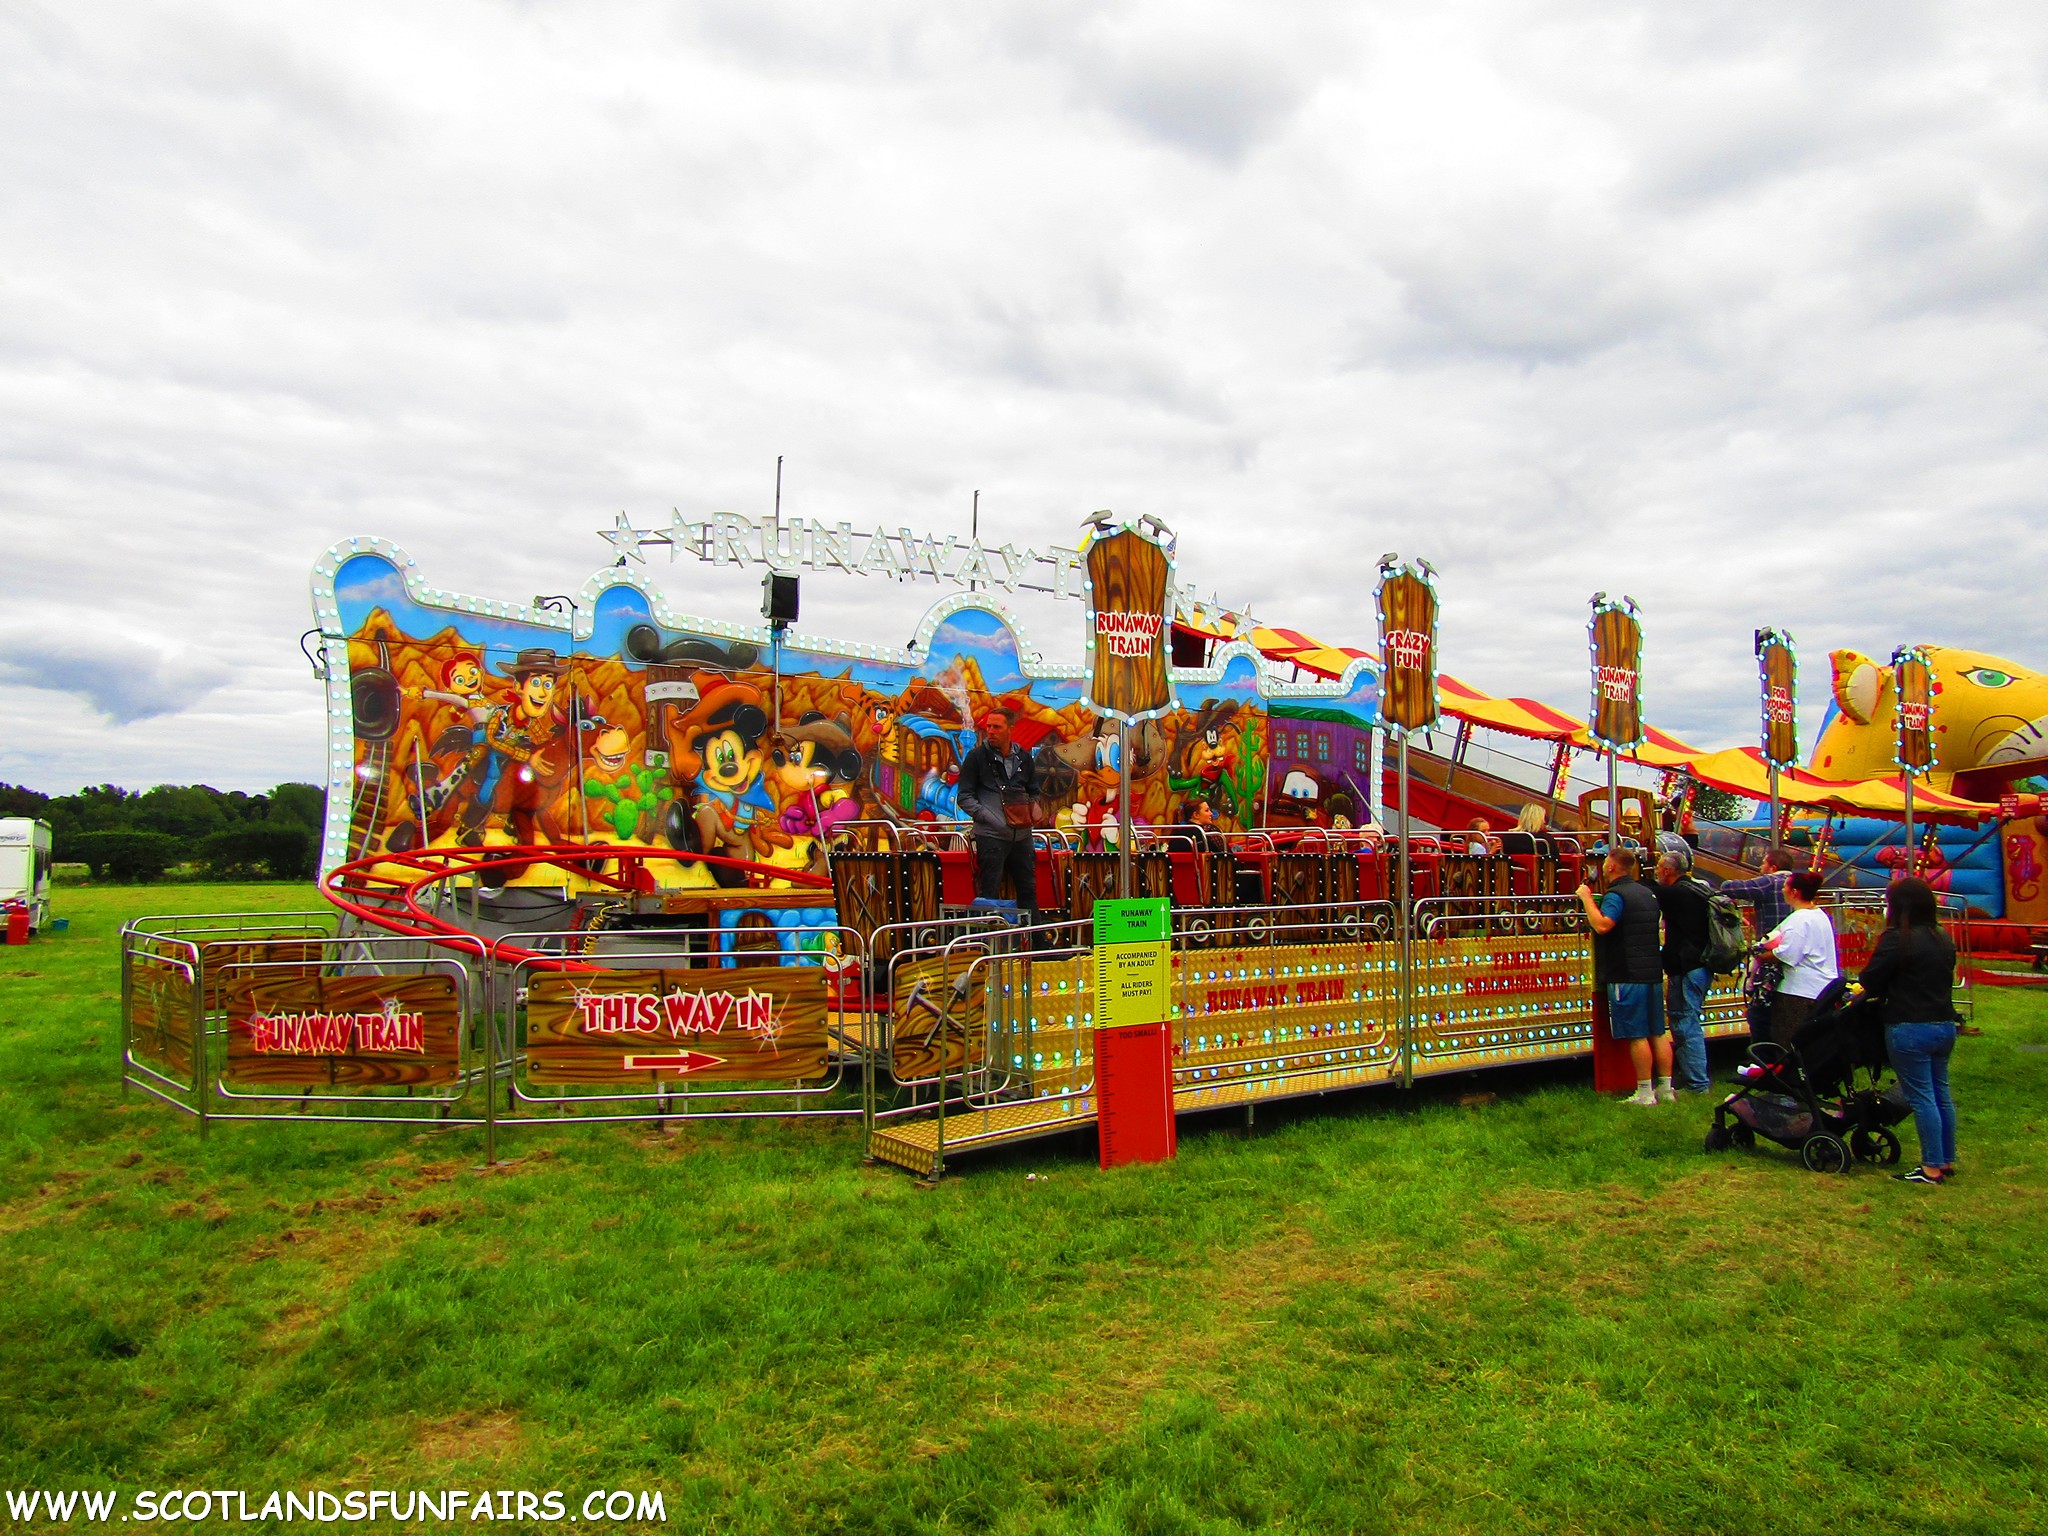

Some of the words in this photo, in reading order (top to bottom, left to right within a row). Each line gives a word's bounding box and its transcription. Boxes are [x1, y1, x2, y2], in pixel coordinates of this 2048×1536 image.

[711, 511, 1036, 594] RUNAWAY
[1096, 610, 1163, 638] RUNAWAY
[1108, 635, 1152, 658] TRAIN
[1385, 629, 1431, 655] CRAZY
[1395, 651, 1422, 672] FUN
[1597, 665, 1637, 688] RUNAWAY
[1604, 683, 1630, 703] TRAIN
[1771, 686, 1786, 700] FOR
[1766, 697, 1792, 714] YOUNG
[1776, 711, 1790, 724] OLD
[1120, 909, 1153, 918] RUNAWAY
[1127, 920, 1147, 928] TRAIN
[1115, 951, 1158, 961] ACCOMPANIED
[1118, 961, 1127, 969] BY
[1127, 960, 1136, 968] AN
[1137, 959, 1155, 967] ADULT
[1122, 989, 1139, 998] MUST
[1139, 988, 1152, 997] PAY!
[1132, 980, 1153, 989] RIDERS
[1206, 984, 1288, 1013] RUNAWAY
[1296, 978, 1345, 1003] TRAIN
[578, 992, 661, 1034] THIS
[663, 986, 736, 1039] WAY
[735, 987, 773, 1031] IN
[254, 1009, 354, 1056] RUNAWAY
[354, 1008, 425, 1054] TRAIN
[1118, 1031, 1133, 1040] TOO
